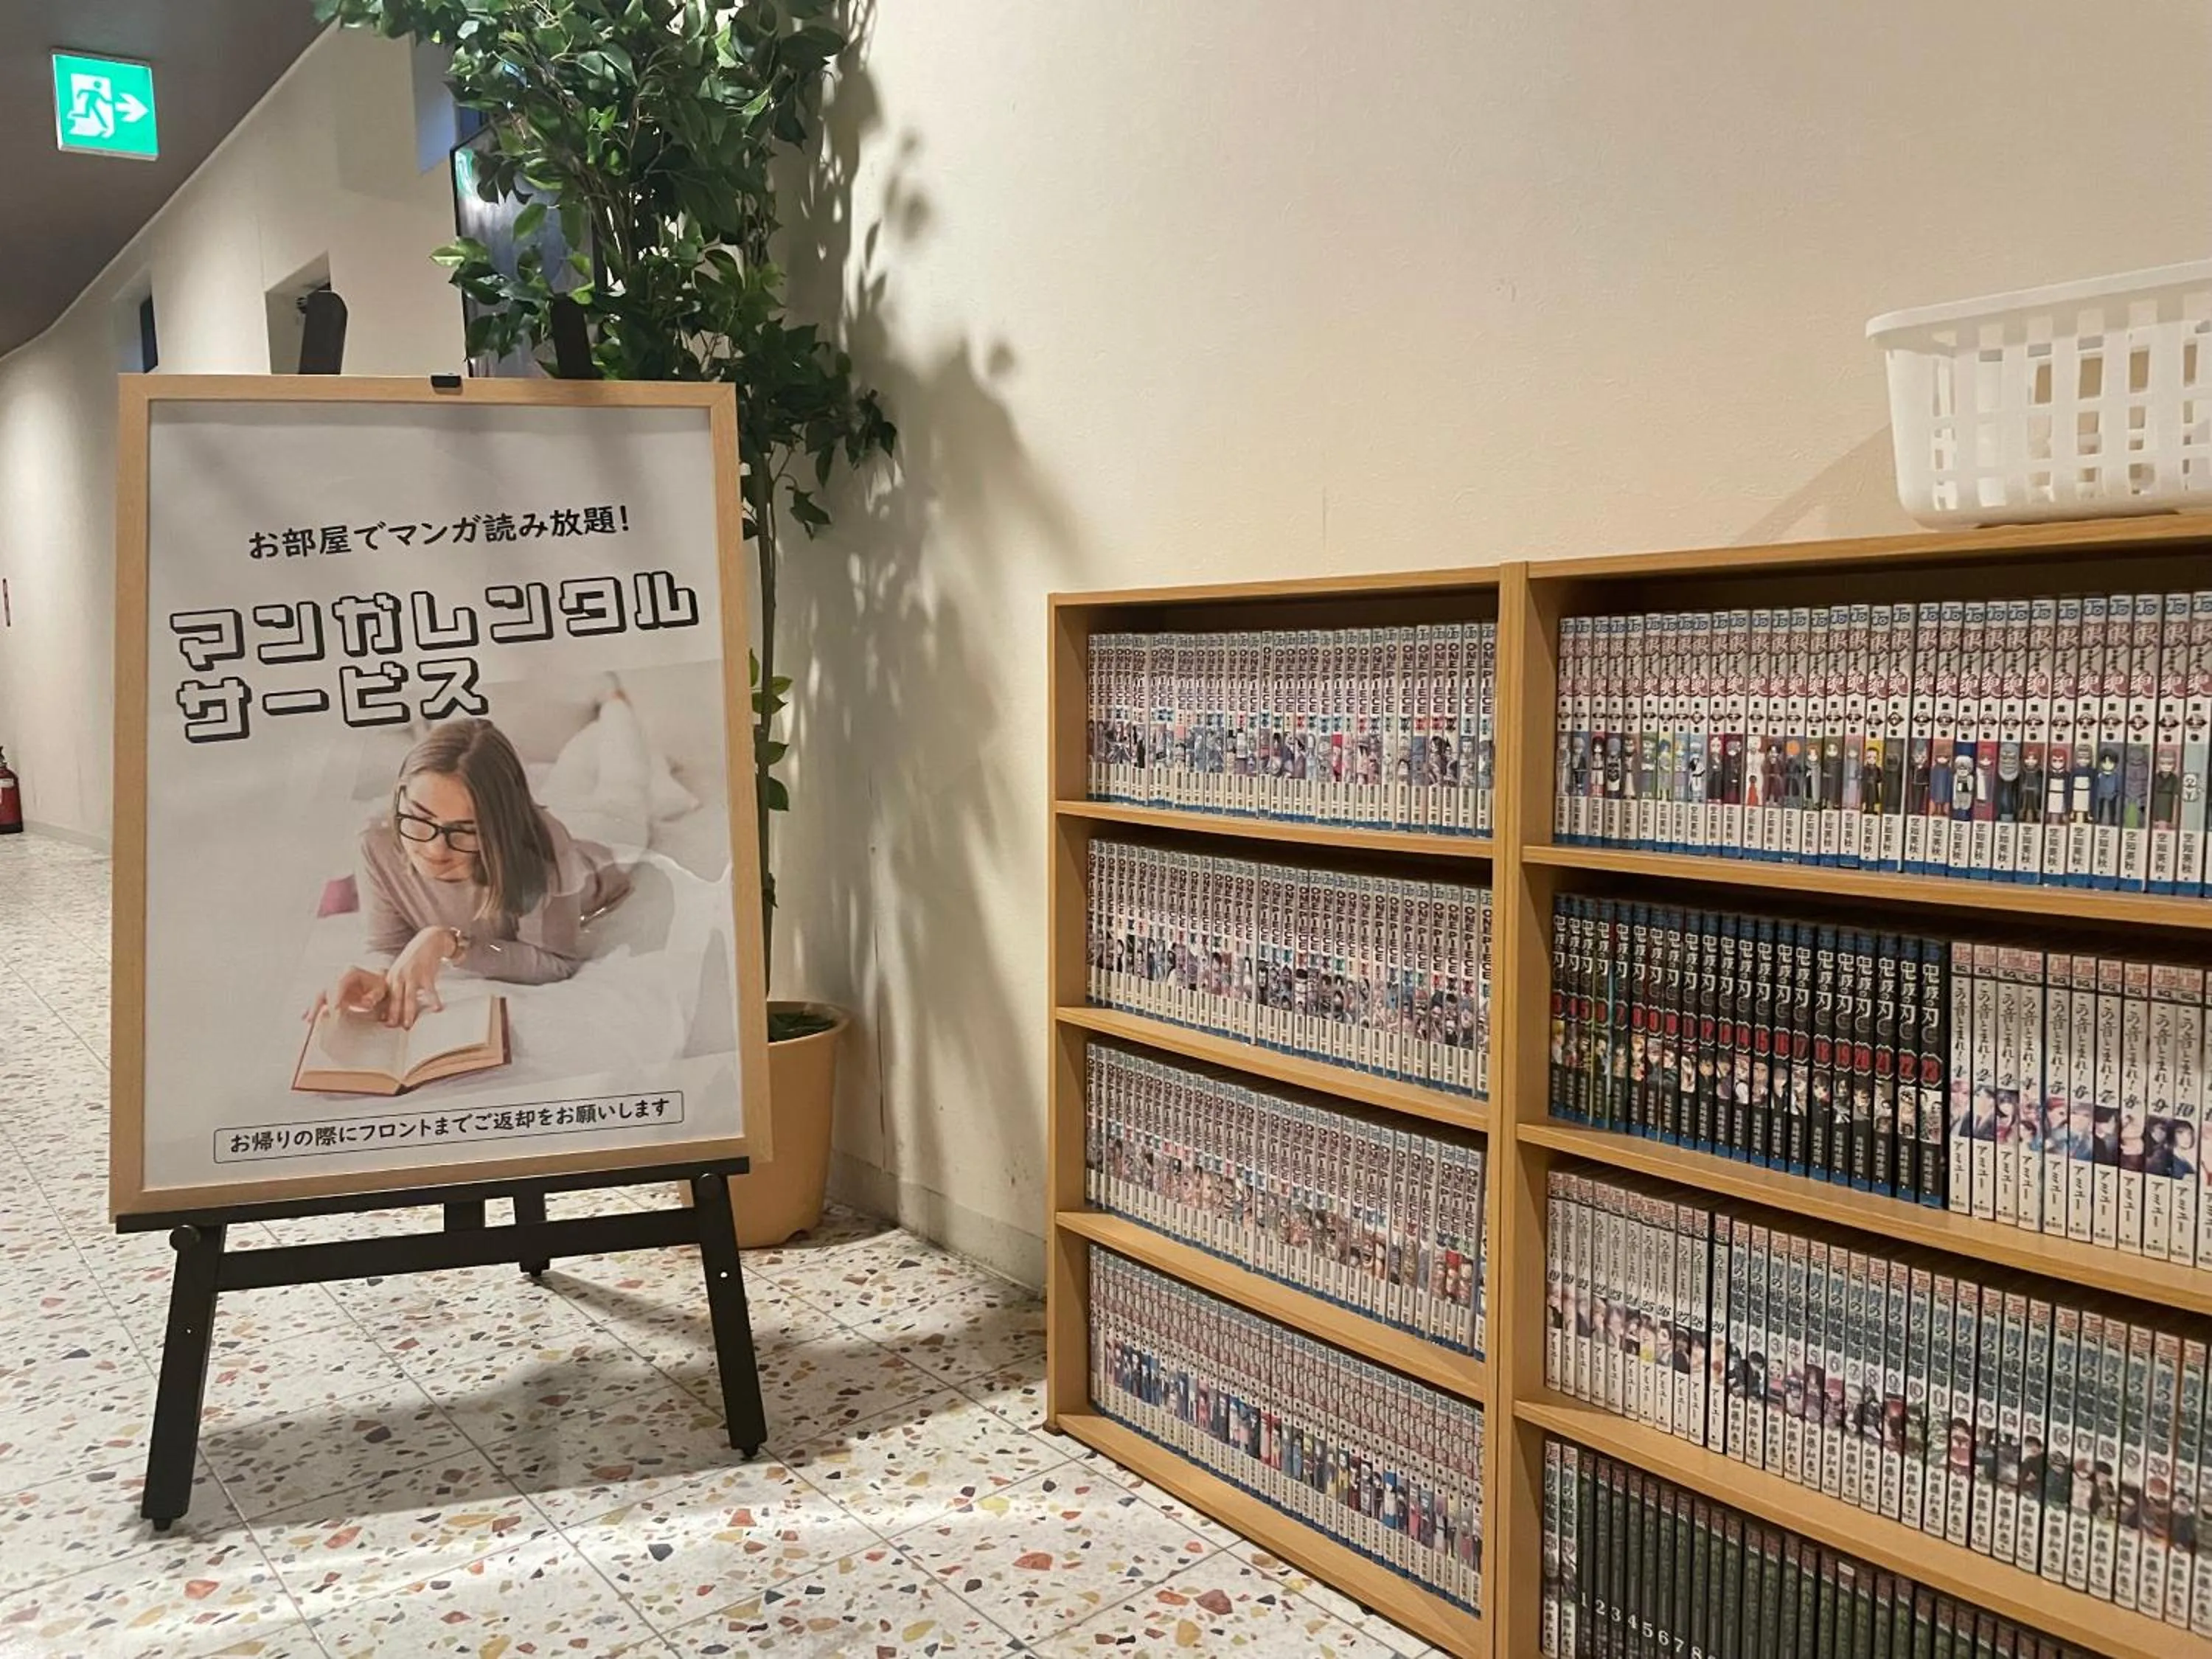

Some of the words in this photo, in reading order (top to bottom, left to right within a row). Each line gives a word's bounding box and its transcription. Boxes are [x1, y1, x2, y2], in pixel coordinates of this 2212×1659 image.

[248, 504, 630, 560] お部屋でマンガ読み放題!
[170, 571, 699, 670] マンガレンタル
[176, 658, 488, 742] サービス
[230, 1098, 669, 1154] お帰りの際にフロントまでご返却をお願いします
[1595, 1599, 1605, 1615] 2
[1611, 1607, 1621, 1622] 3
[1628, 1615, 1637, 1629] 4
[1642, 1621, 1654, 1638] 5
[1658, 1630, 1669, 1646] 6
[1674, 1637, 1684, 1652] 7
[1691, 1646, 1702, 1659] 8
